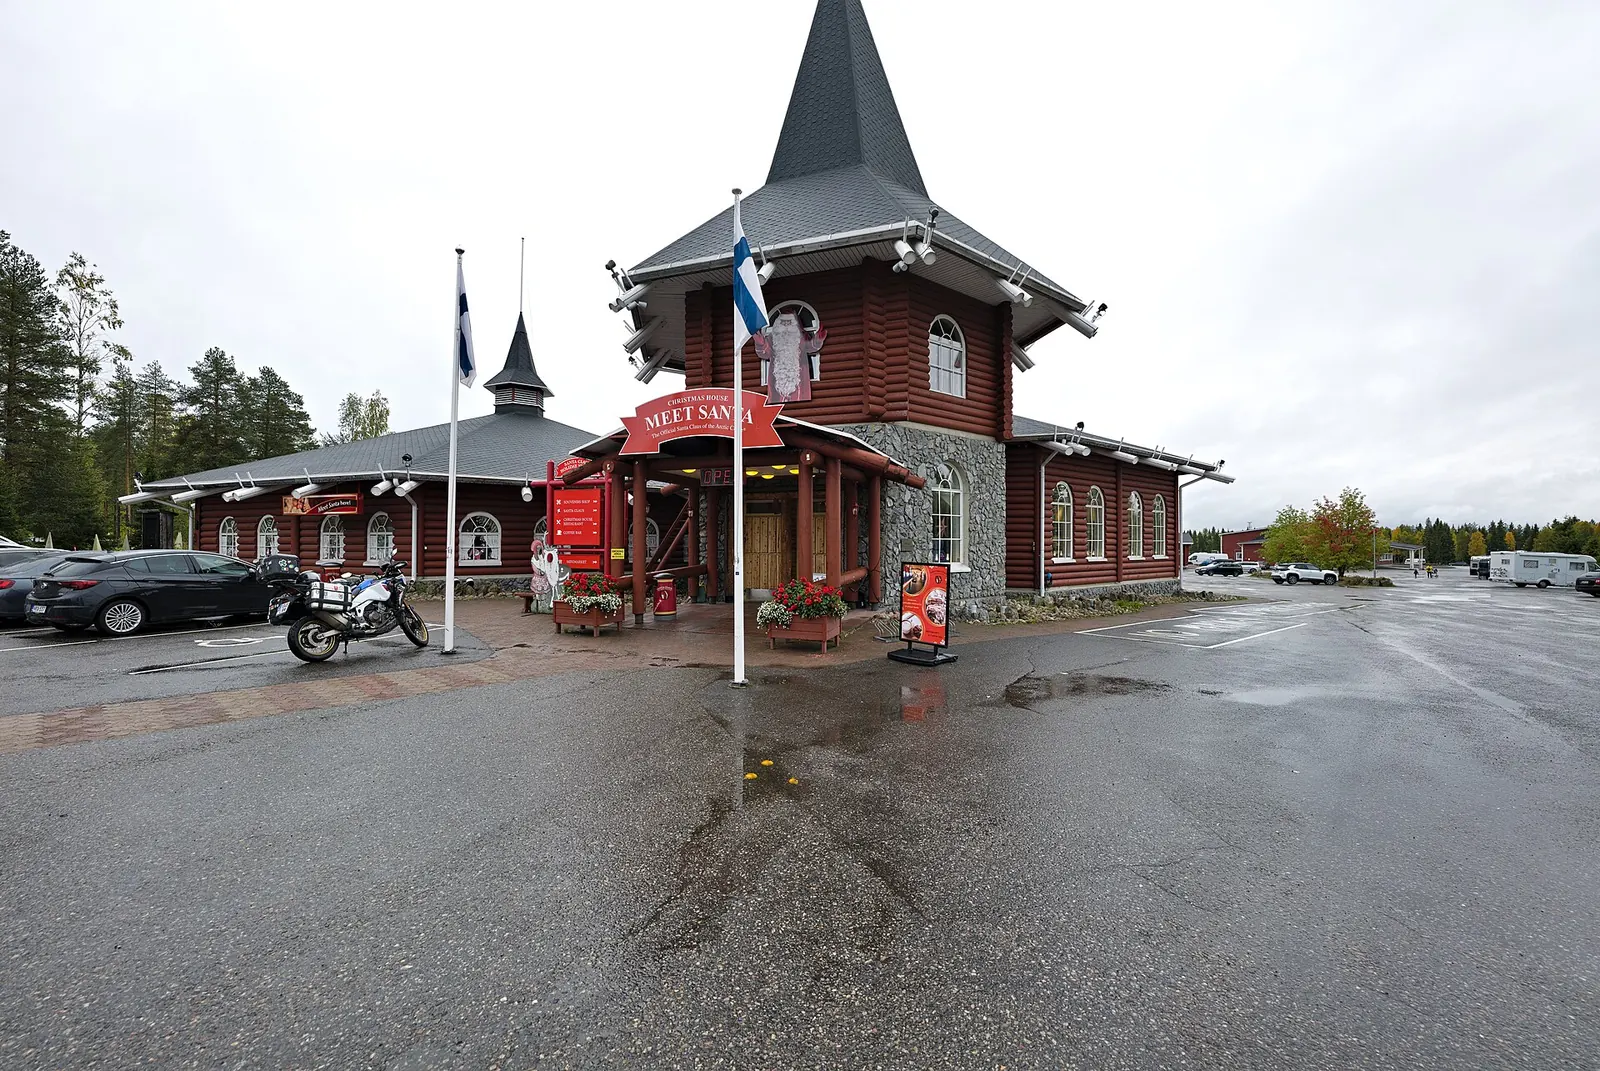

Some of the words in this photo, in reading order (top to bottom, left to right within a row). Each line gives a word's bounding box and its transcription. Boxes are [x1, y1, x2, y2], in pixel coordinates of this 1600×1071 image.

[667, 395, 705, 406] CHRISTMAS
[706, 394, 729, 402] HOUSE
[644, 406, 694, 430] MEET
[660, 428, 676, 436] Official
[704, 470, 731, 484] OPE
